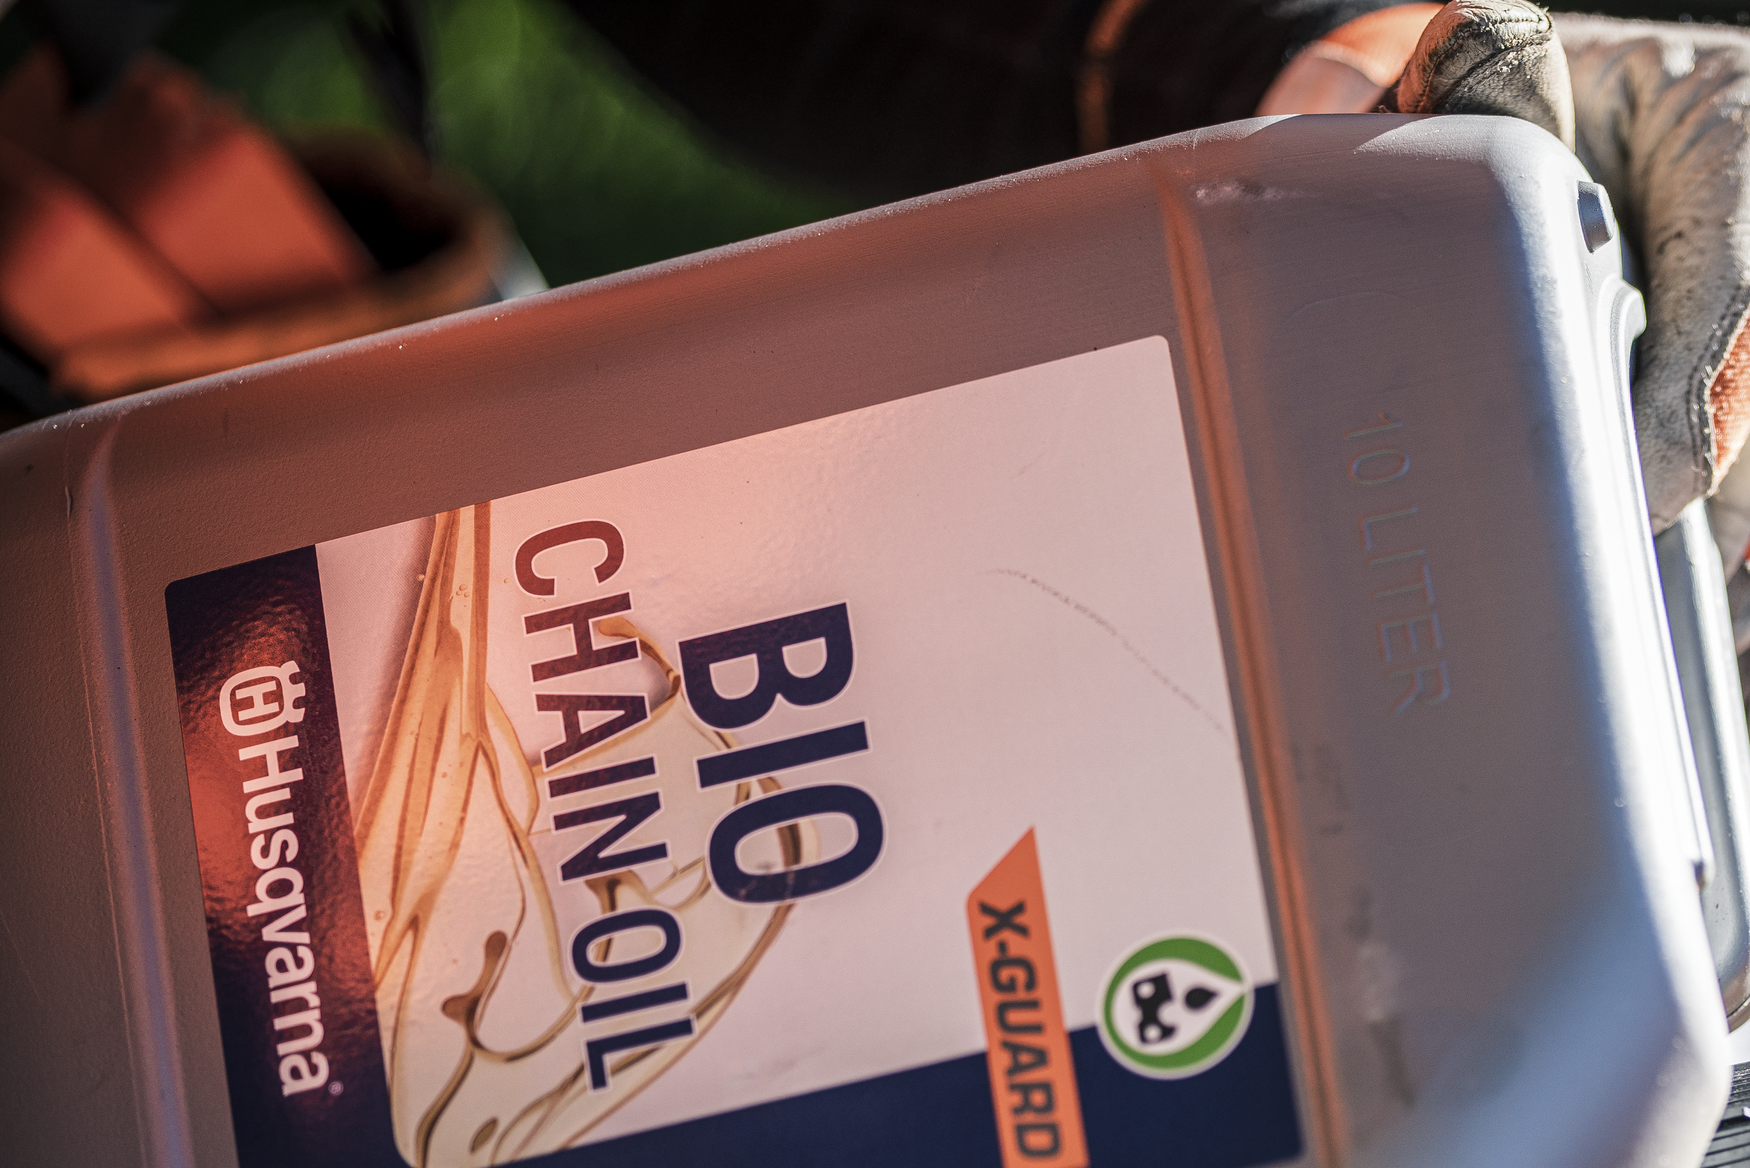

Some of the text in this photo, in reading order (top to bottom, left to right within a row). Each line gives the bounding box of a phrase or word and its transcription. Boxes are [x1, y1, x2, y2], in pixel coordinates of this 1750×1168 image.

[1341, 410, 1450, 715] 10 LITER
[514, 519, 693, 1090] CHAIN OIL
[679, 602, 884, 904] BIO
[978, 900, 1062, 1160] X-GUARD
